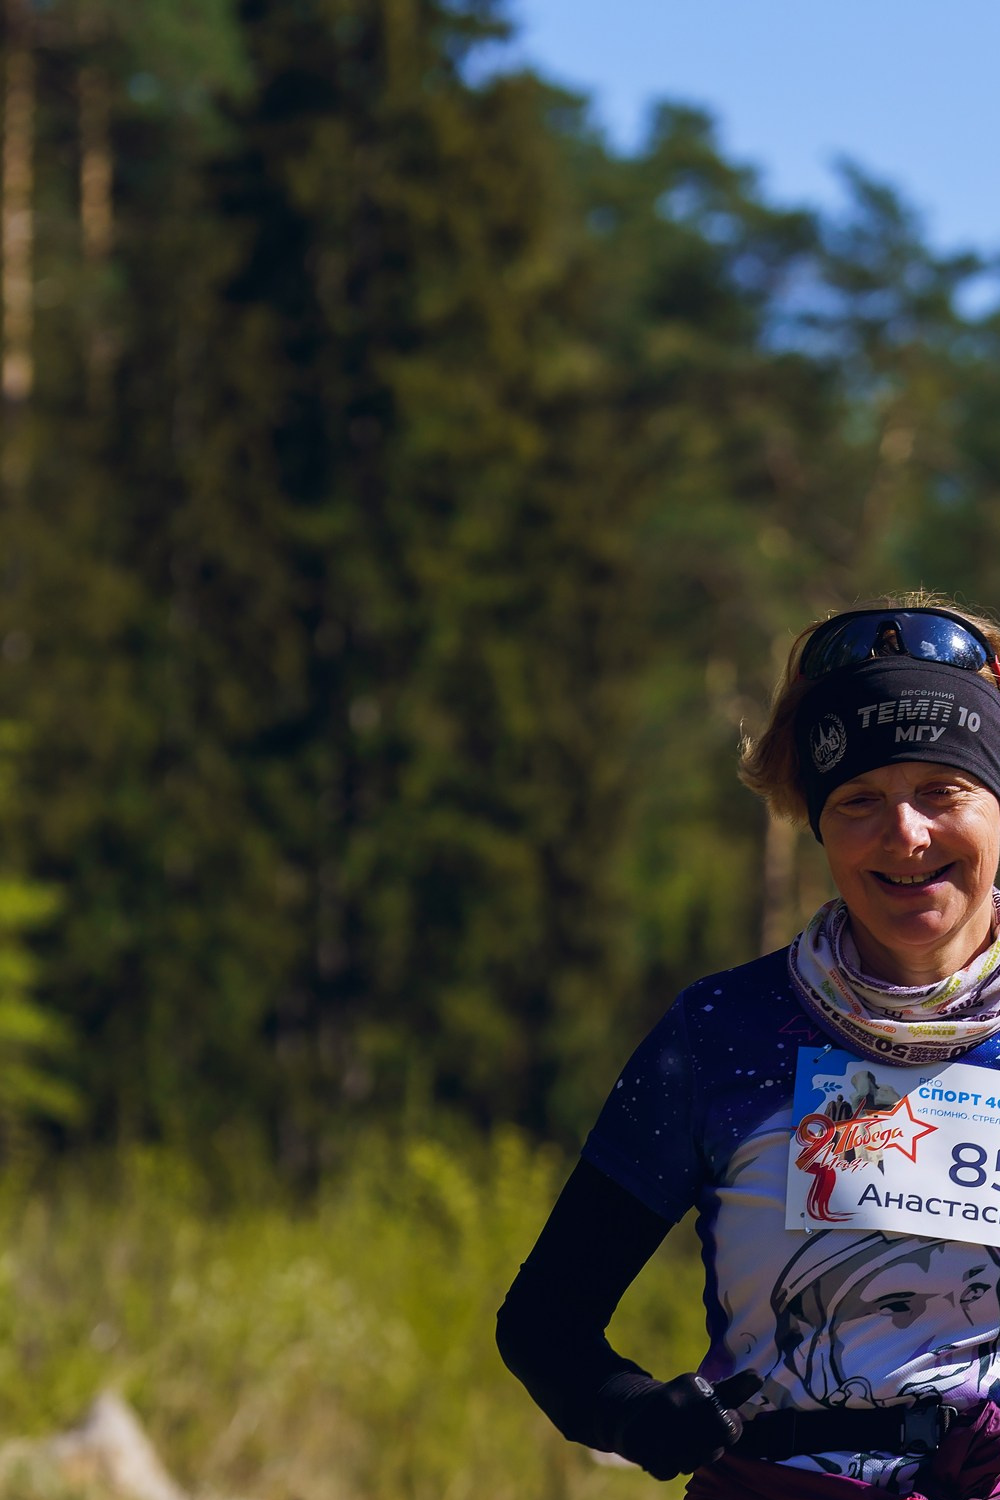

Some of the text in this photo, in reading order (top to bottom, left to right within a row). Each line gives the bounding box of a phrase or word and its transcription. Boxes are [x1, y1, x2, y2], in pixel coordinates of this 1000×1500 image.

[901, 689, 955, 700] весенний
[857, 699, 981, 733] ТЕМП 10
[895, 725, 947, 743] МГУ
[875, 1037, 910, 1058] 50
[919, 1077, 943, 1088] PRO
[918, 1087, 982, 1106] СПОРТ
